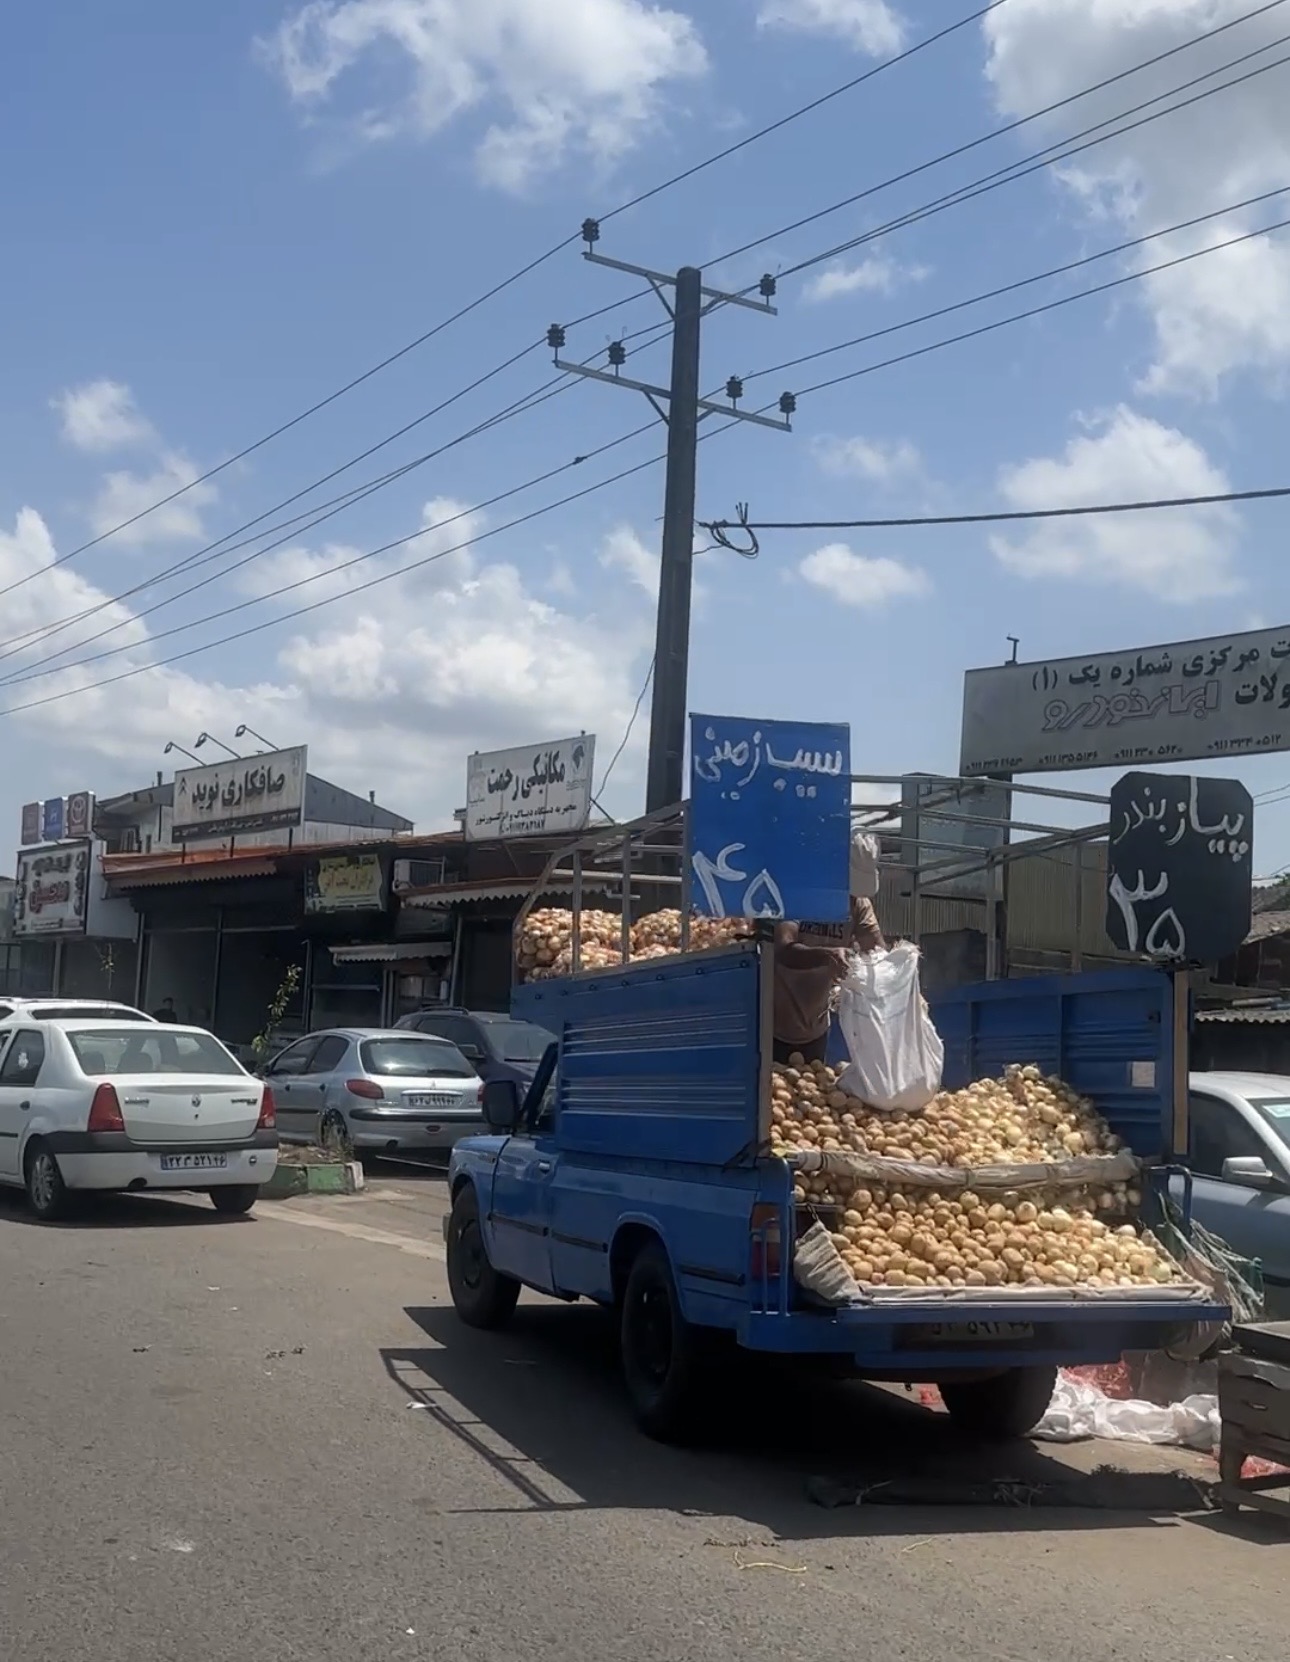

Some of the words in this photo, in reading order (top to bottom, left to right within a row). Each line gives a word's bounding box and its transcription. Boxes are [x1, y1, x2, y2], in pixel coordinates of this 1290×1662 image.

[1068, 664, 1101, 688] یک
[1110, 652, 1172, 687] شماره
[1182, 645, 1260, 677] مرکزی
[192, 773, 220, 811] نوید
[221, 765, 286, 808] صافکاری
[521, 750, 566, 799] مکانیکی
[1112, 787, 1166, 845] بندر
[1165, 777, 1248, 862] پیاز
[692, 843, 785, 918] ۴۵
[1110, 868, 1186, 956] ۳۵
